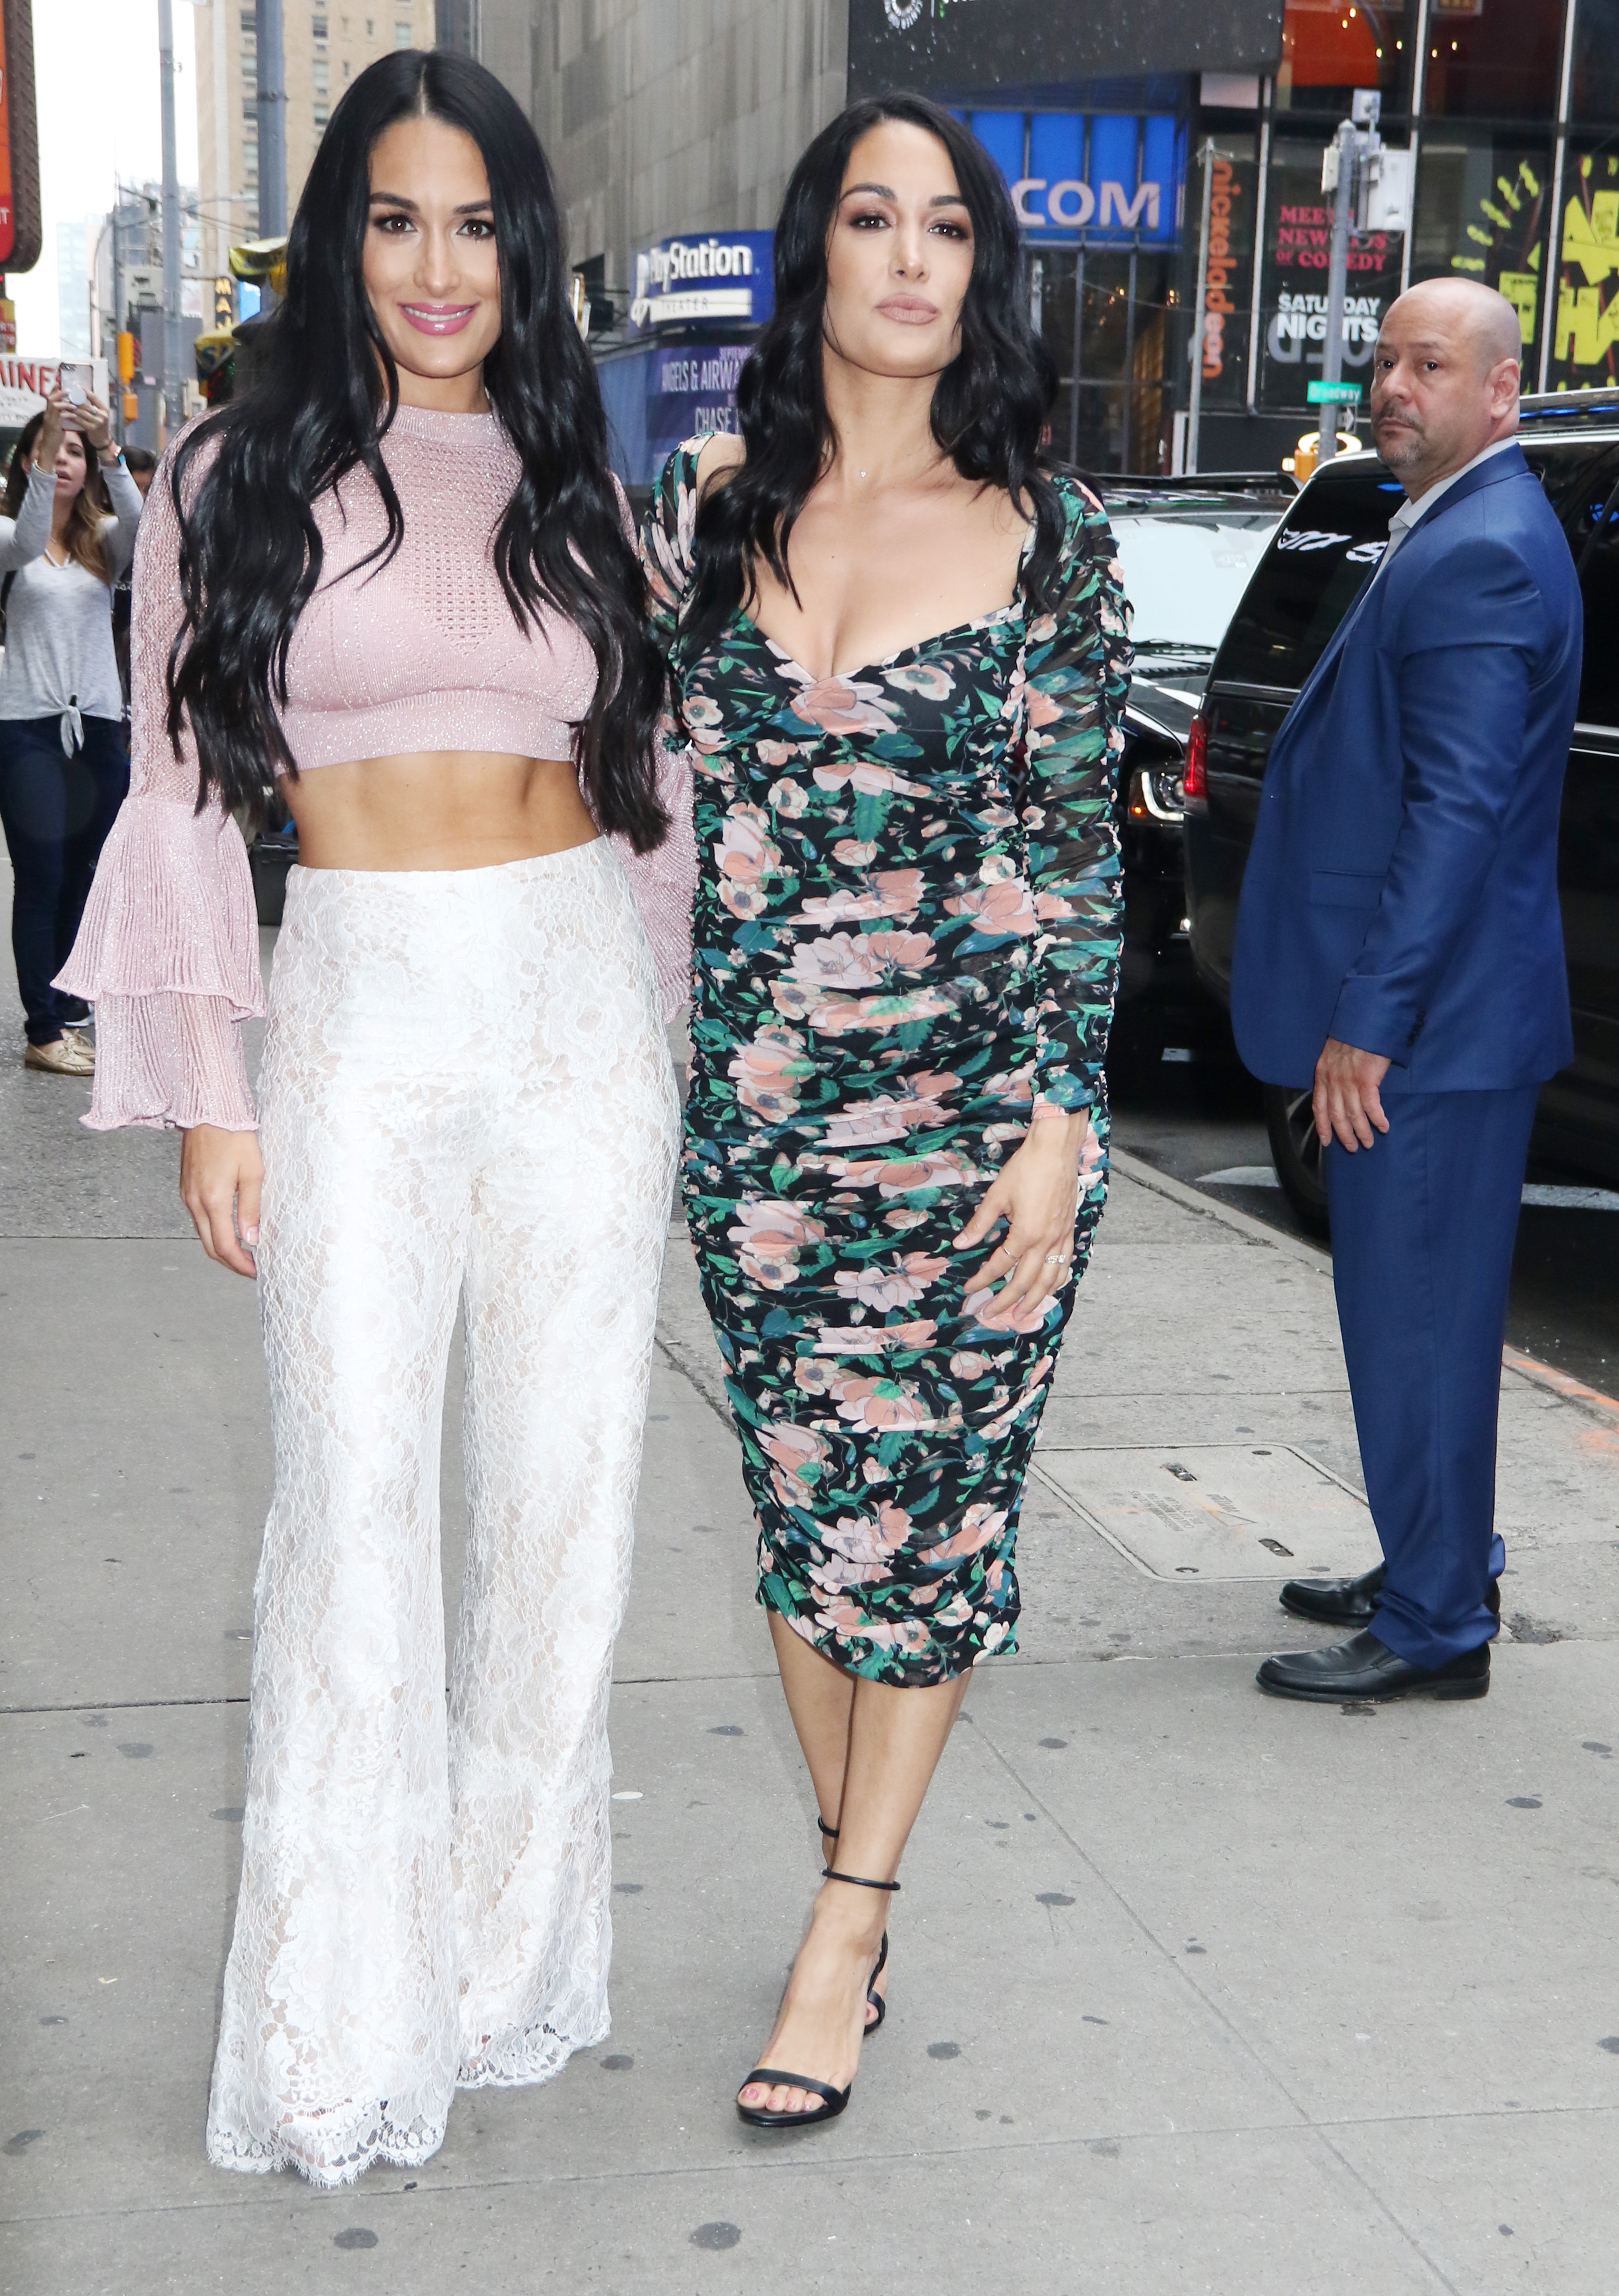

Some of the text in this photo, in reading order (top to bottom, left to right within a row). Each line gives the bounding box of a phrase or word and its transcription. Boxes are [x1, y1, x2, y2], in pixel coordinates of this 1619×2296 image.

[1010, 178, 1160, 228] COM
[1278, 227, 1328, 246] NEW
[1298, 250, 1387, 272] COEDY
[1278, 293, 1381, 316] SATUDAY
[690, 359, 698, 392] &
